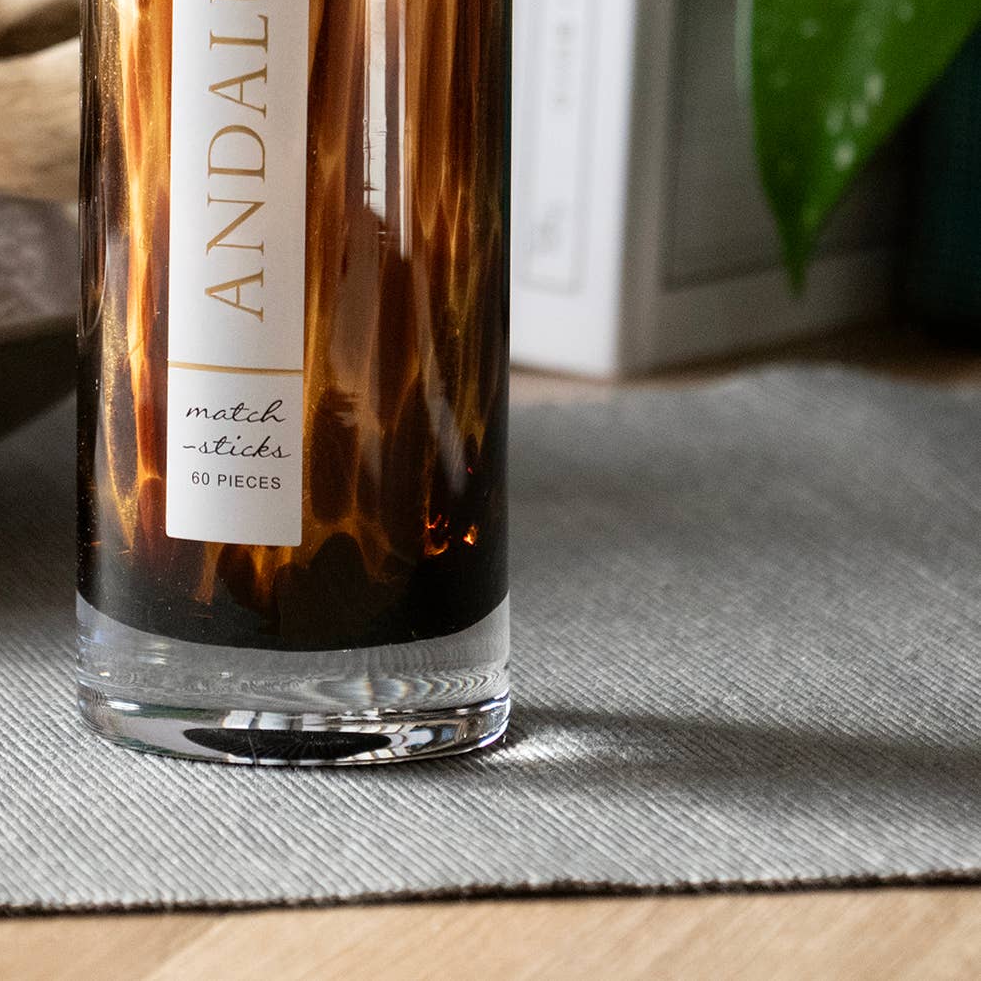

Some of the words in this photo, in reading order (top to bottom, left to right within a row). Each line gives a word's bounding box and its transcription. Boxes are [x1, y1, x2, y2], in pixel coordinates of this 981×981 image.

[185, 399, 286, 423] match
[191, 470, 211, 486] 60
[217, 474, 282, 490] PIECES
